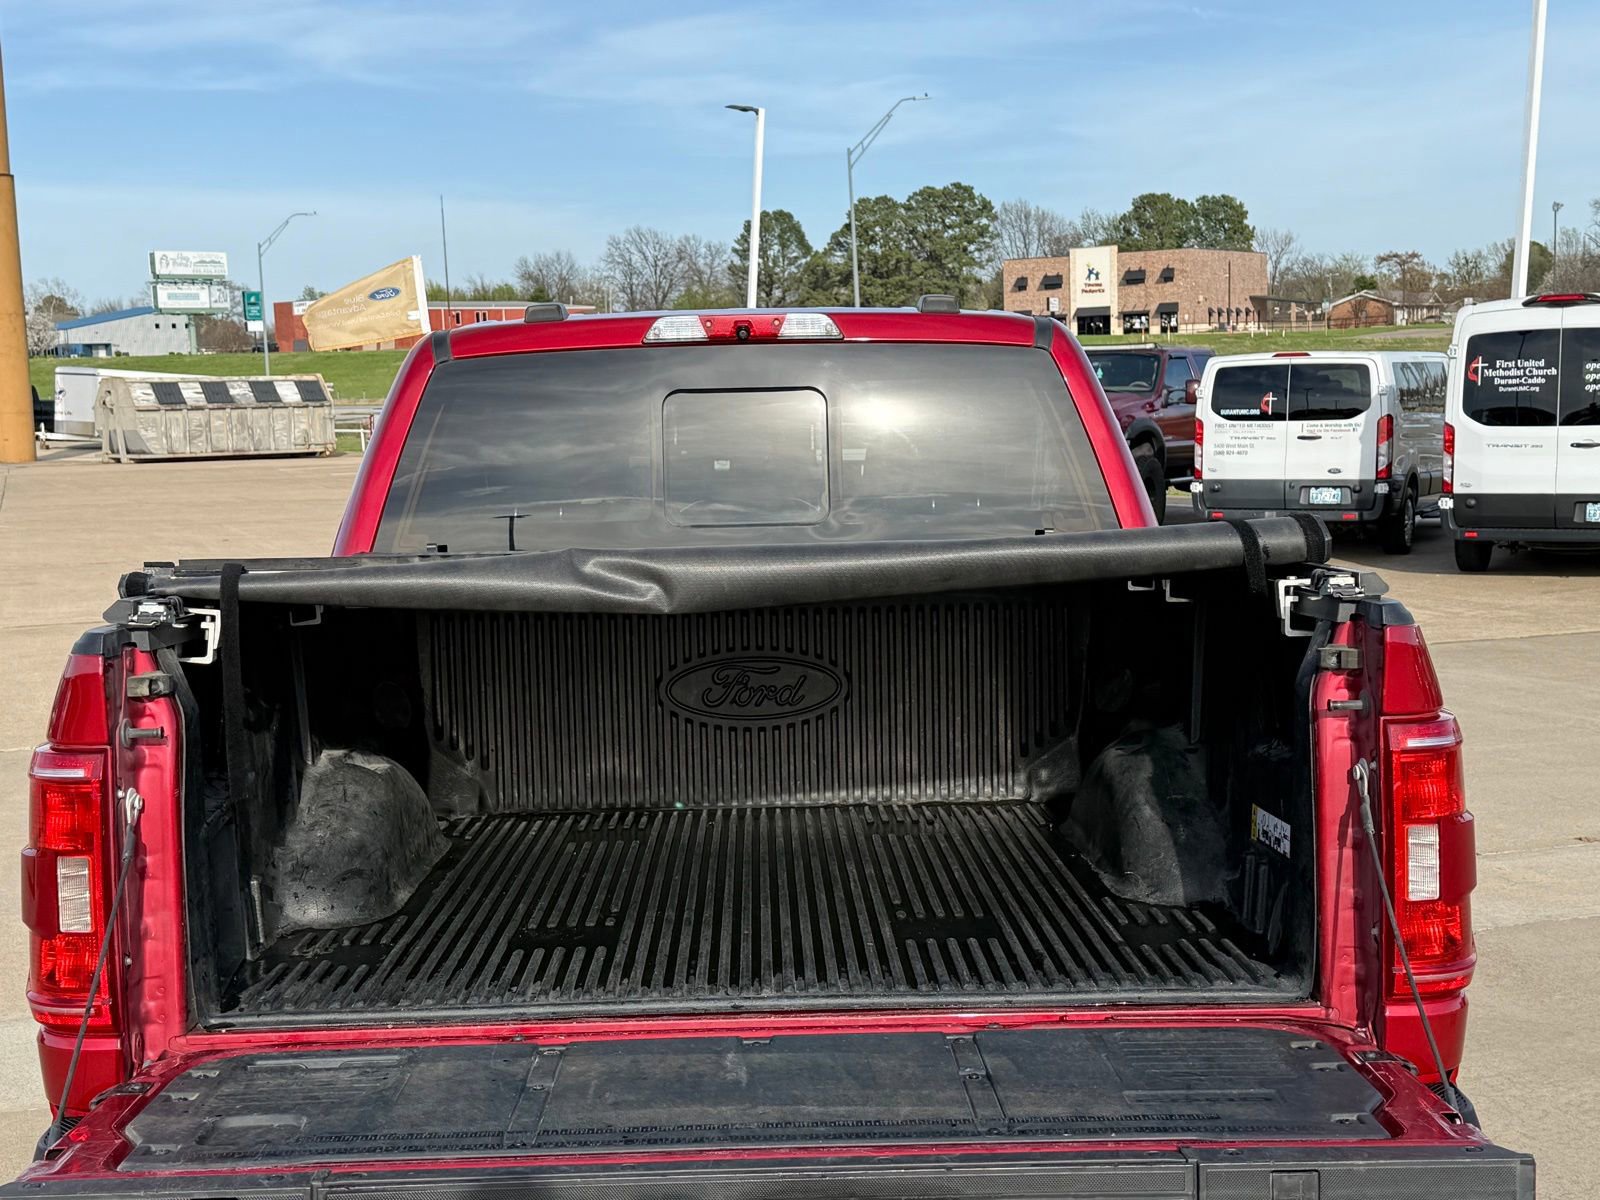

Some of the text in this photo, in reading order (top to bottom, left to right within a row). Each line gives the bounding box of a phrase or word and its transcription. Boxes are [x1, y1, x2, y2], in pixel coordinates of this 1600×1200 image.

[1496, 359, 1545, 368] First United
[1483, 367, 1557, 377] Methodist Church
[1494, 376, 1546, 385] Durant-Caddo
[703, 666, 806, 708] Ford
